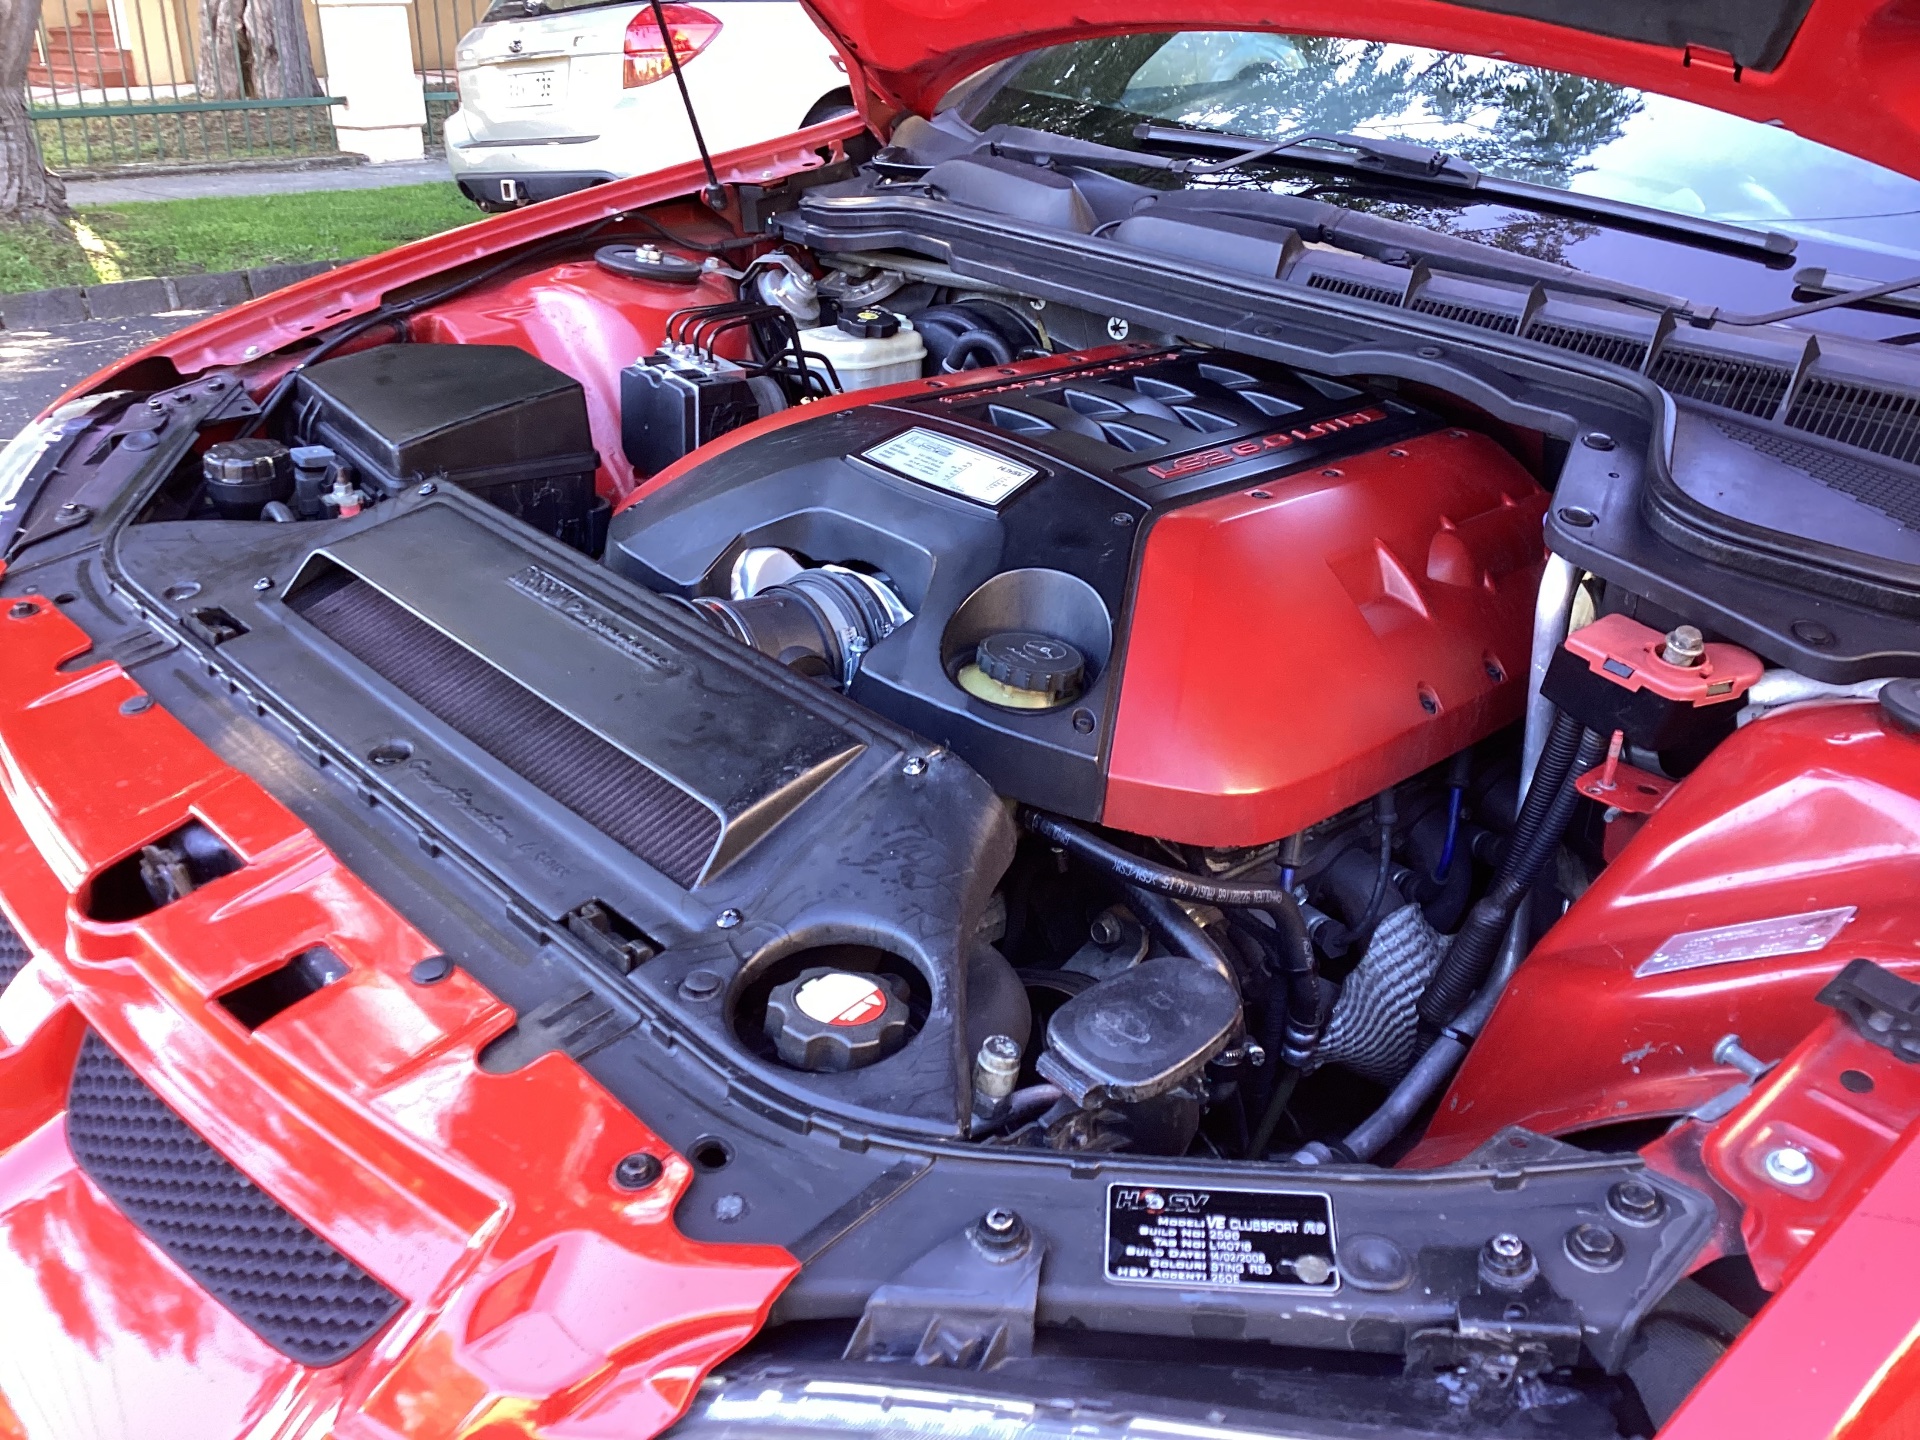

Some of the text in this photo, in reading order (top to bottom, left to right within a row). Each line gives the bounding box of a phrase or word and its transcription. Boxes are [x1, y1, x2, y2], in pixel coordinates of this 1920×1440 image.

[1206, 1214, 1227, 1230] VE
[1229, 1217, 1299, 1234] CLUBSPORT
[1138, 1225, 1178, 1238] BUILD
[1125, 1245, 1165, 1258] BUILD
[1210, 1261, 1245, 1274] STING
[1248, 1263, 1273, 1276] RED
